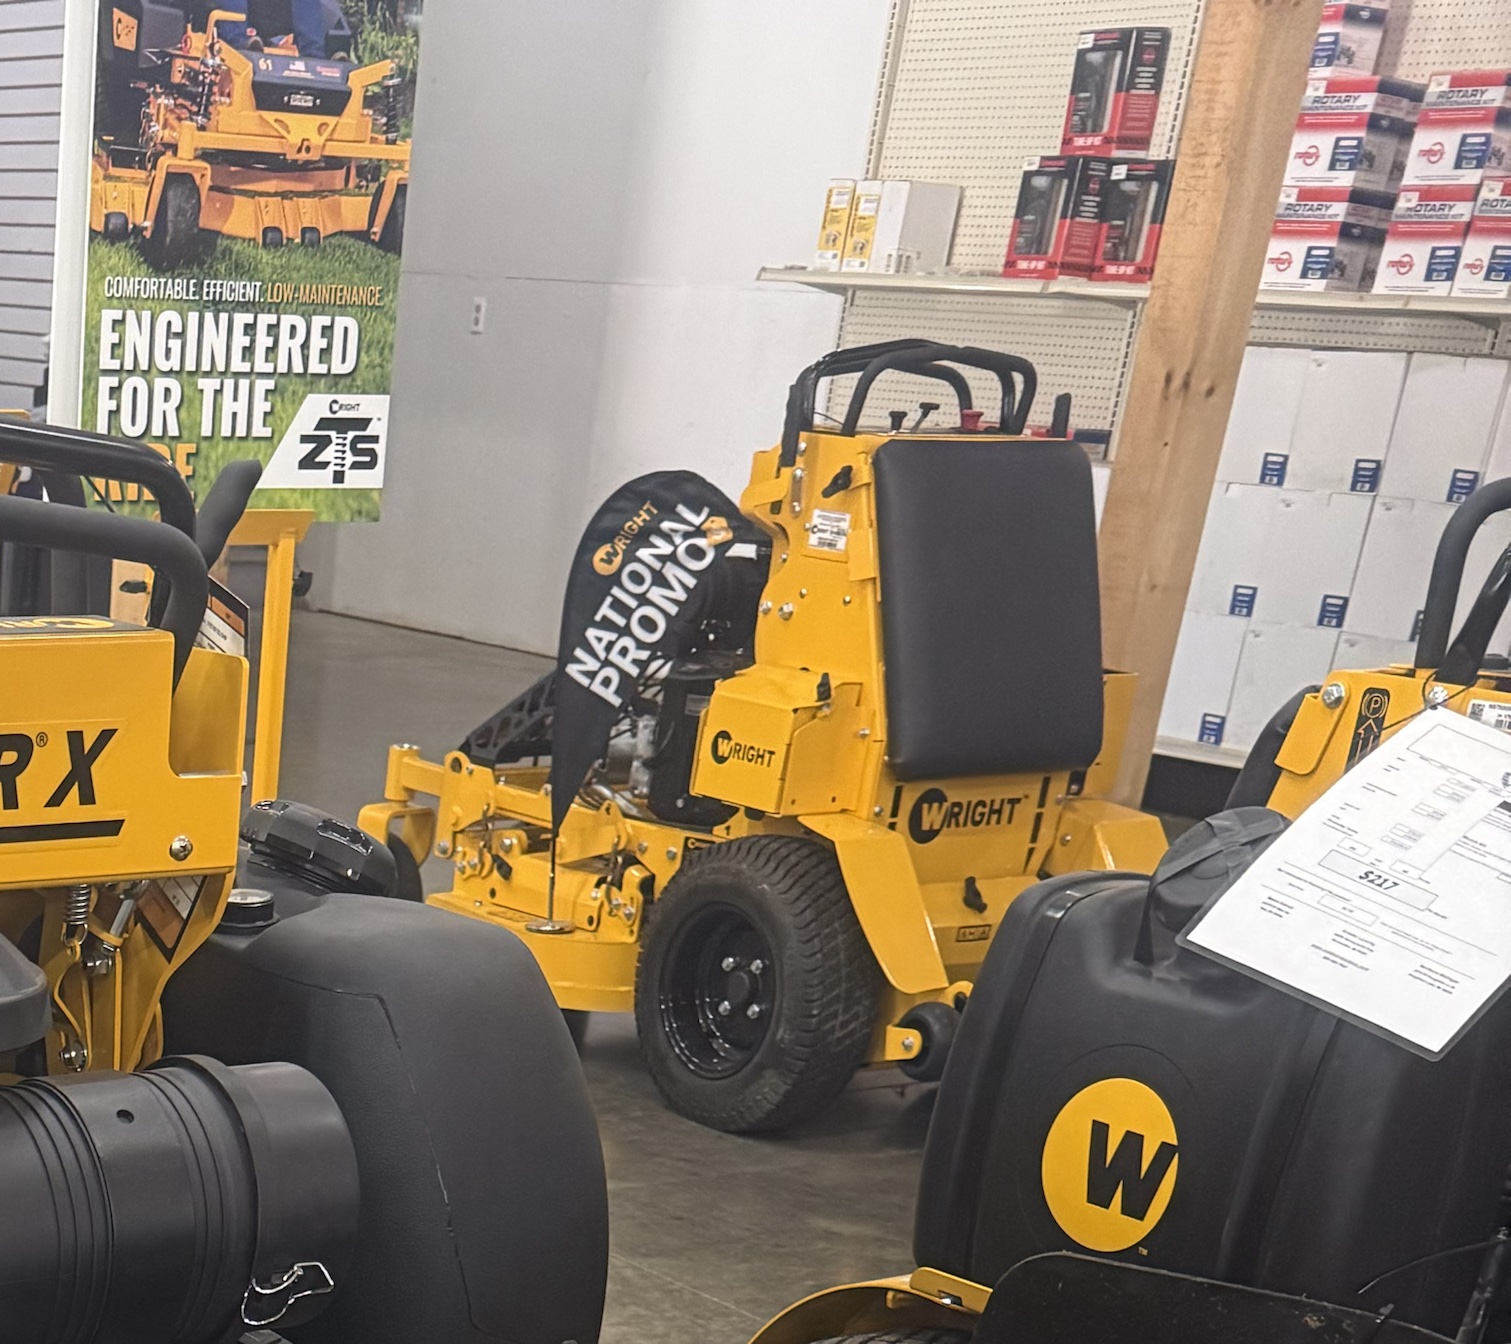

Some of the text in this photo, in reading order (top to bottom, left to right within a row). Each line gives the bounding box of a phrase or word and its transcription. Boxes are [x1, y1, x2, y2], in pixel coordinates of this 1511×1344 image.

[1312, 94, 1361, 105] ROTARY
[1437, 88, 1488, 100] ROTARY
[1284, 203, 1333, 214] ROTARY
[104, 275, 385, 307] COMFORTABLE. EFFICIENT. LOW-MAINTENANCE.
[99, 309, 360, 375] ENGINEERED
[96, 376, 275, 438] FOR THE
[329, 399, 361, 415] WRIGHT
[592, 501, 659, 576] WRIGHT
[564, 503, 710, 688] NATIONAL
[44, 728, 118, 807] X
[711, 730, 776, 768] WRIGHT
[908, 788, 1023, 844] WRIGHT
[1358, 869, 1400, 891] $217
